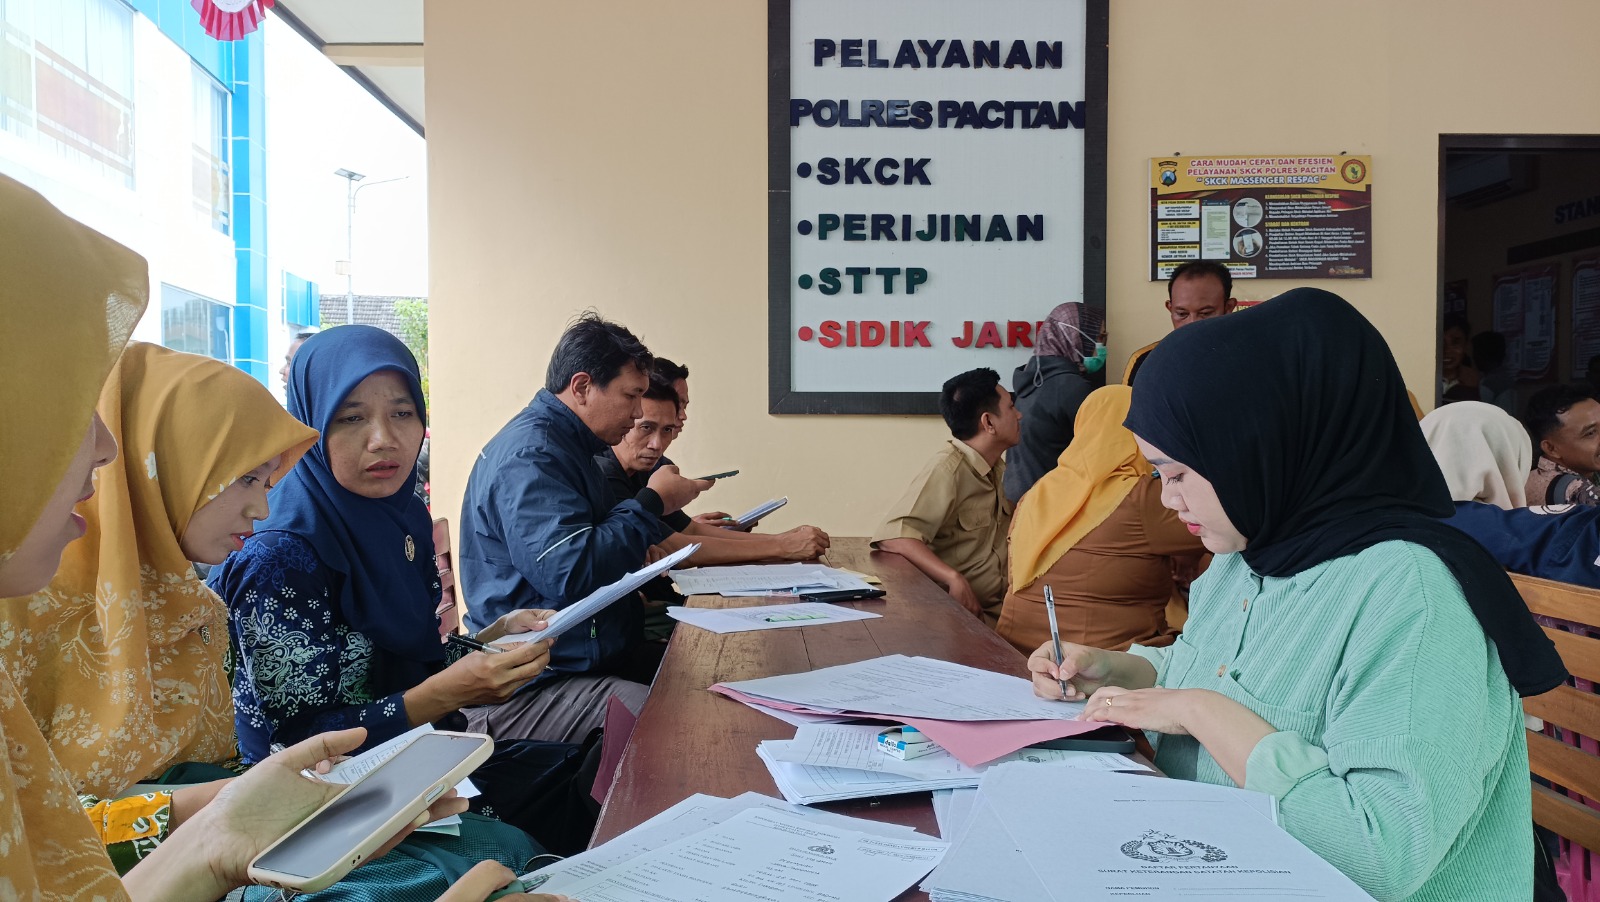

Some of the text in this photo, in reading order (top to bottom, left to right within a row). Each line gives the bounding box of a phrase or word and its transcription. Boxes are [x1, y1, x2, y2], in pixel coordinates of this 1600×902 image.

[813, 38, 1063, 69] PELAYANAN
[790, 99, 1086, 130] POLRES PACITAN
[816, 157, 932, 186] SKCK
[1187, 168, 1237, 176] PELAYANAN
[1239, 167, 1263, 175] SKCK
[1300, 166, 1336, 174] PACITAN
[1190, 159, 1214, 167] CARA
[1249, 158, 1276, 166] CEPAT
[1204, 175, 1320, 186] SKCK MASSENGER RESPAC
[817, 213, 1044, 242] PERIJINAN
[818, 267, 928, 295] STTP
[818, 320, 932, 348] SIDIK
